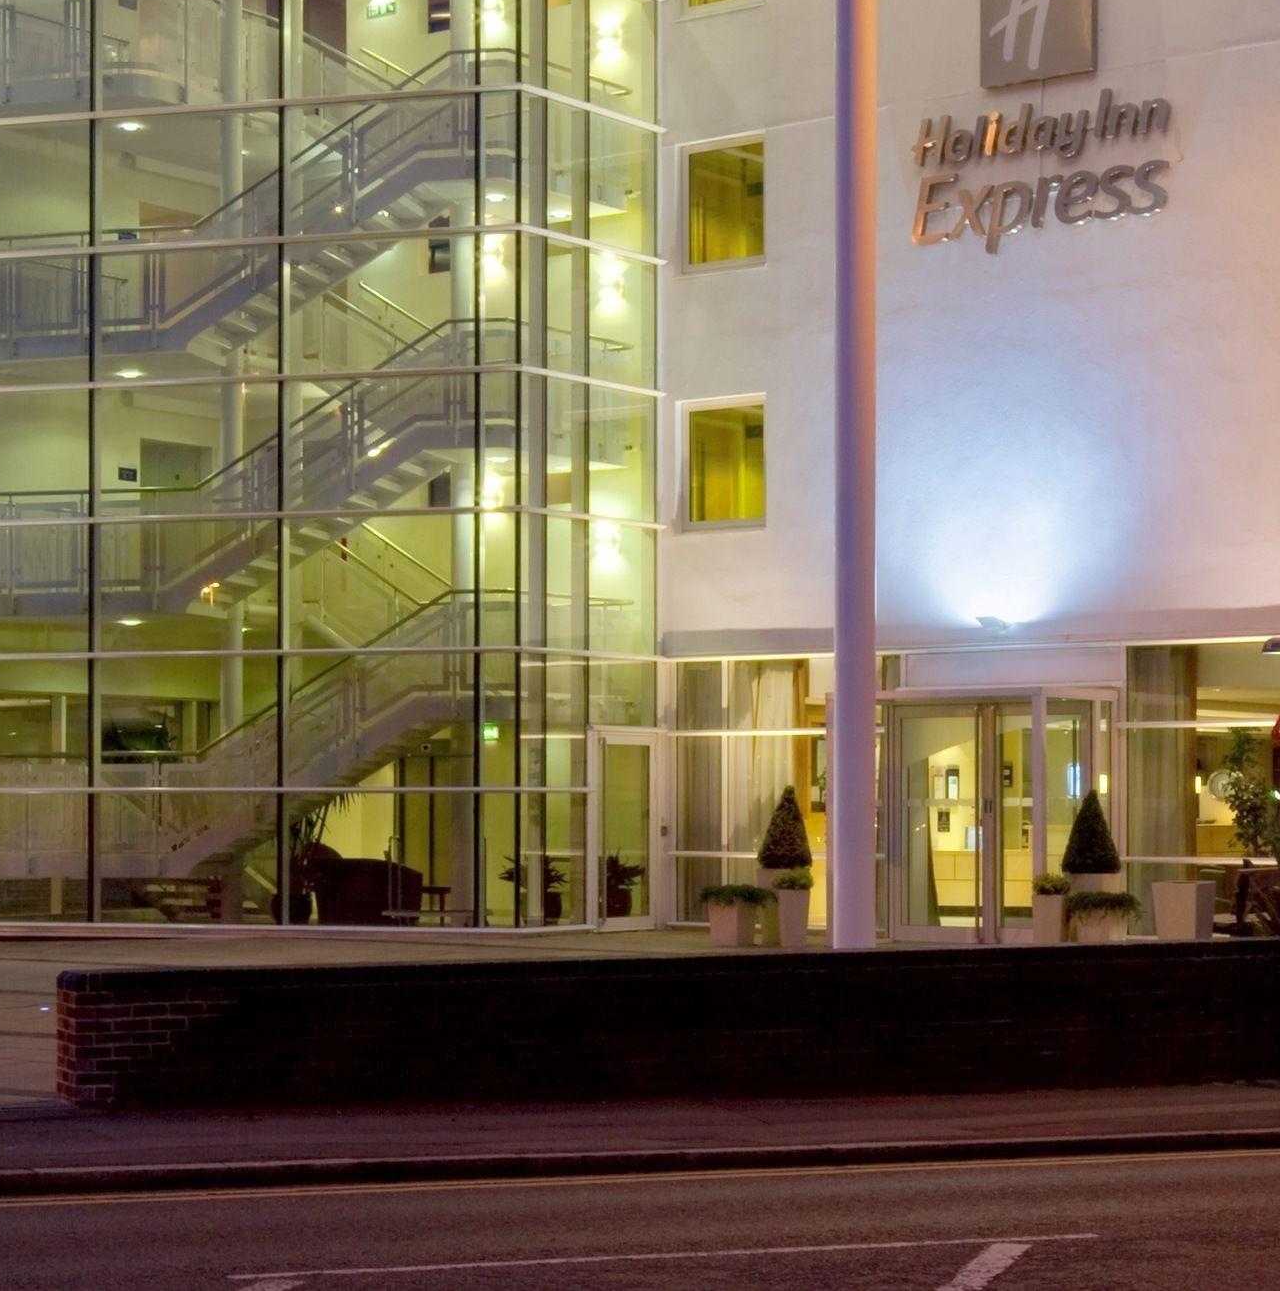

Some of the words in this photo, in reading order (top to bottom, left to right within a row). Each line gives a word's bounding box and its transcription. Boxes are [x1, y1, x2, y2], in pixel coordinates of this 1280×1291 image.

[911, 102, 1091, 167] Holiday
[1093, 88, 1172, 141] Inn
[912, 159, 1171, 255] Express
